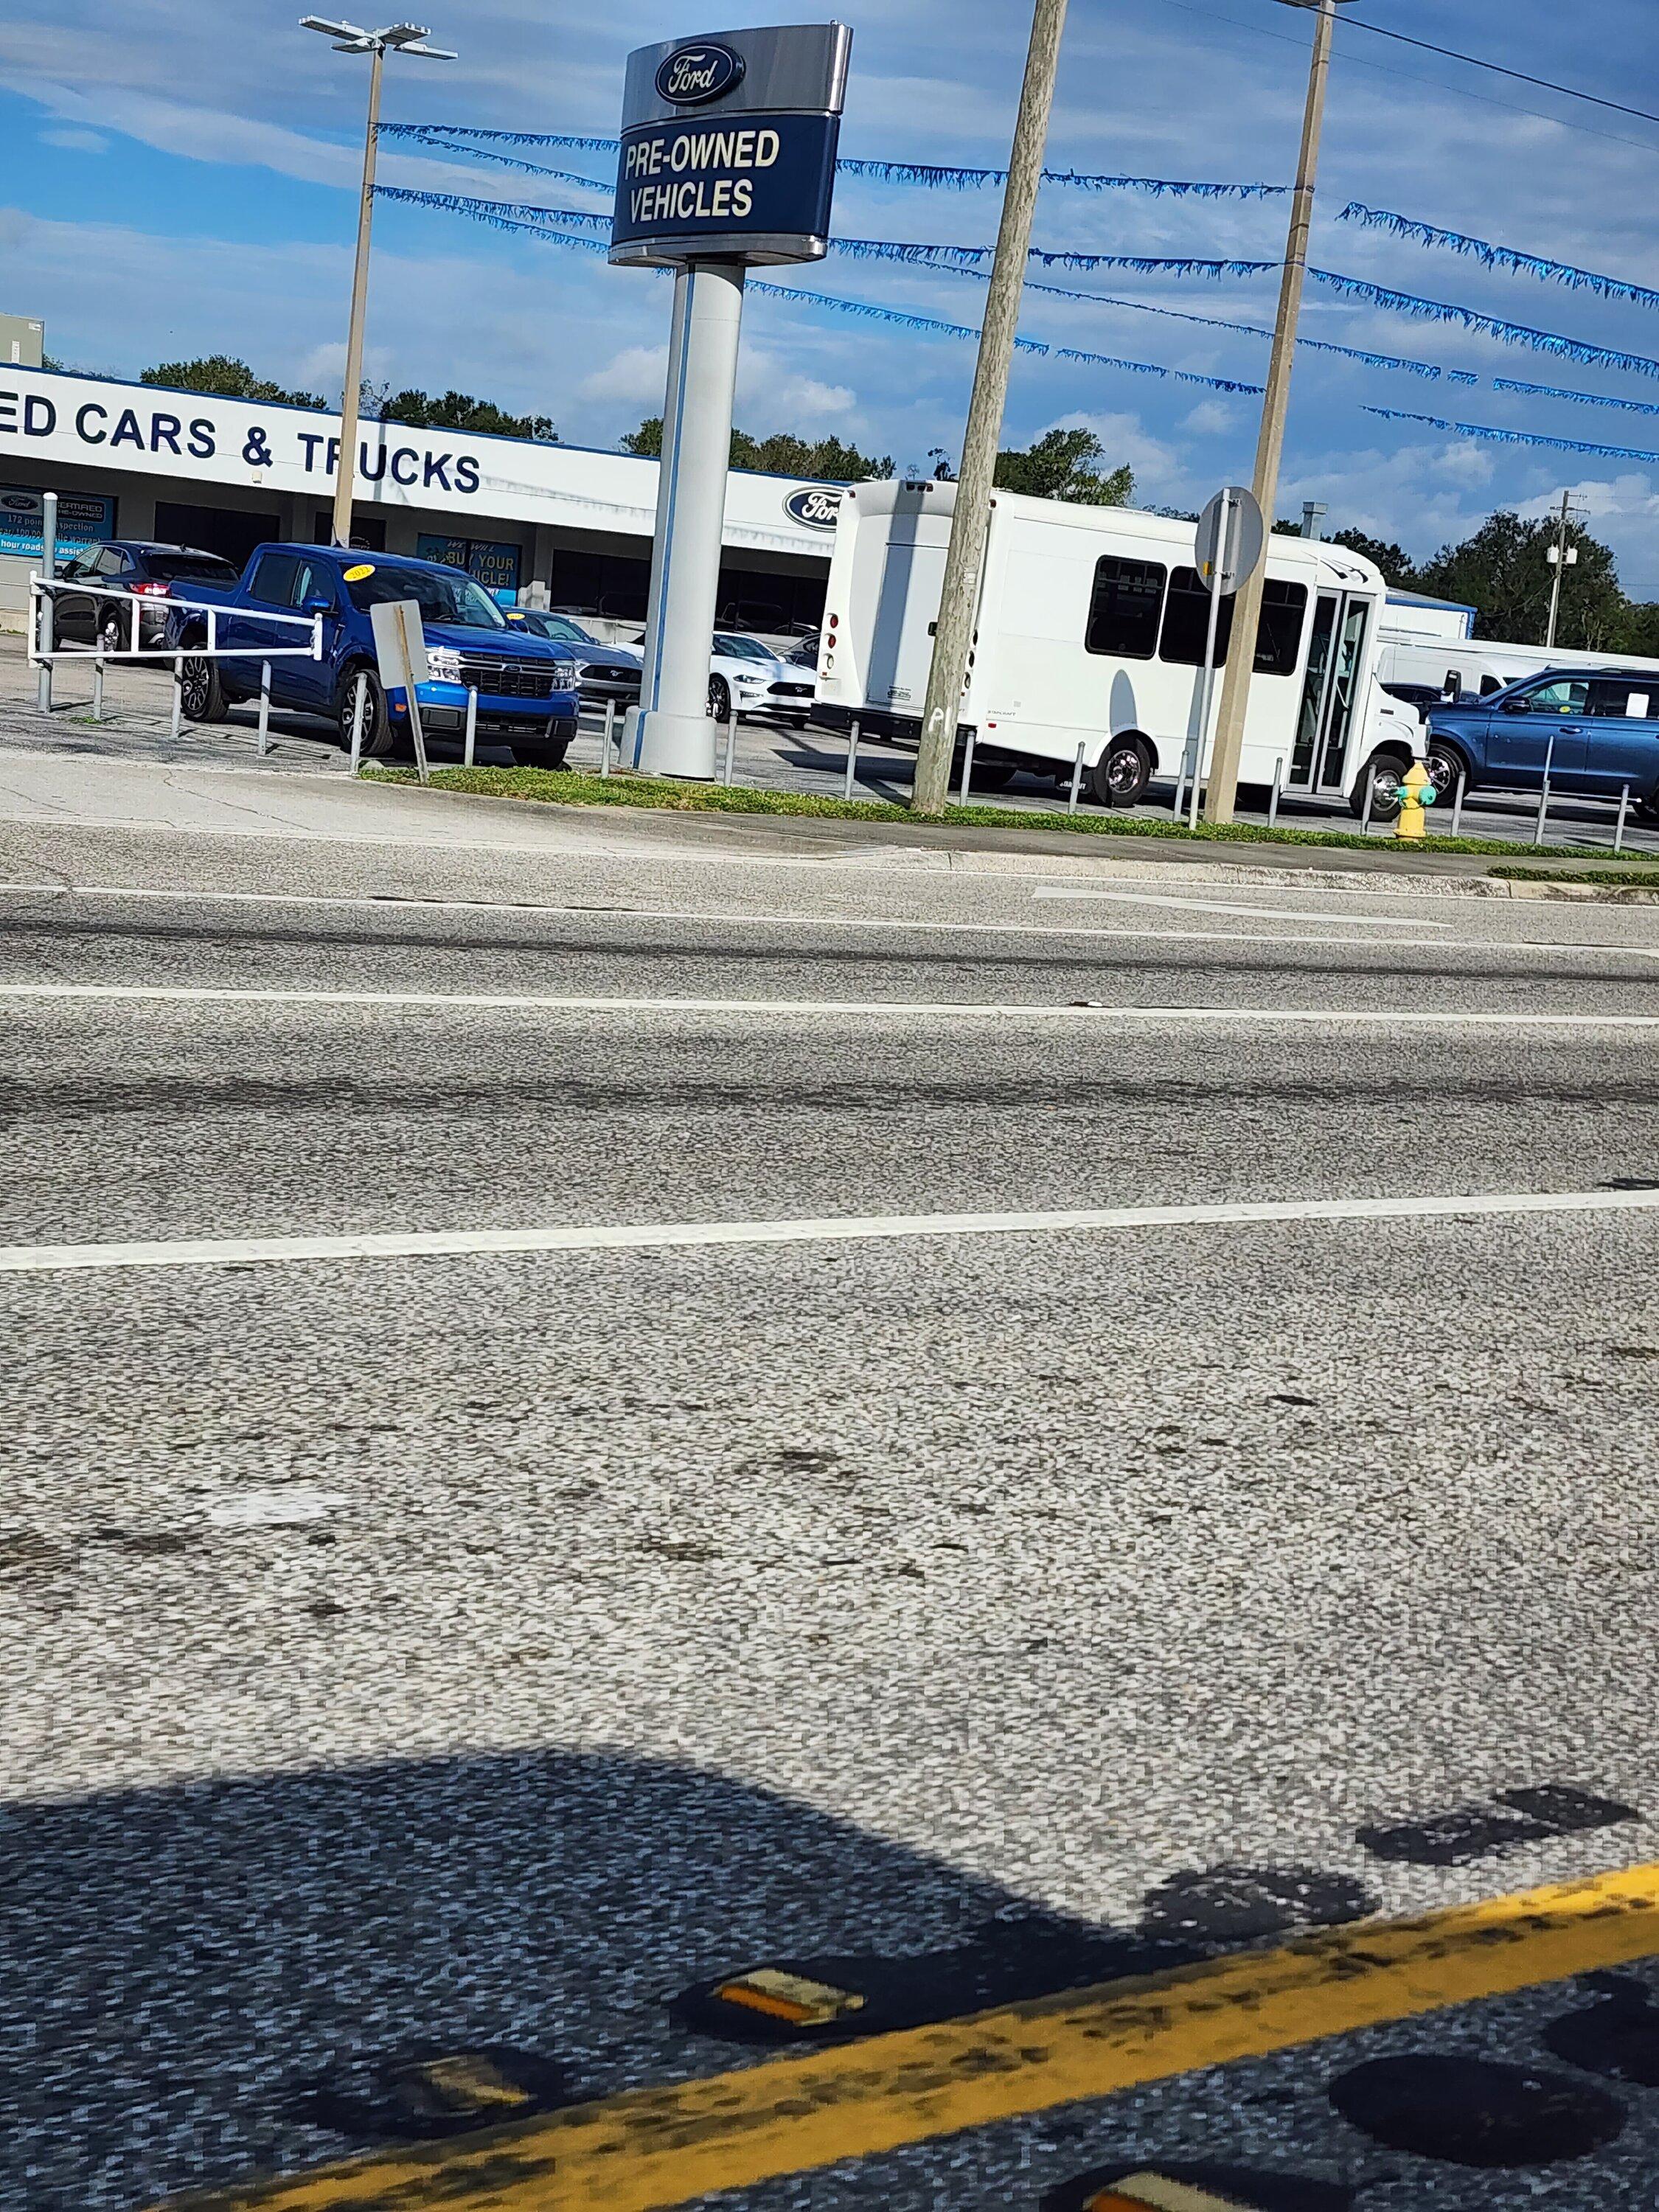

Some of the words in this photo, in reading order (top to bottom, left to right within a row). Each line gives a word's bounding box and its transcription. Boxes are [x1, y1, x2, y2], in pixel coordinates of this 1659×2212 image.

[668, 54, 718, 94] Ford
[625, 130, 779, 181] PRE-OWNED
[630, 178, 753, 223] VEHICLES
[75, 403, 216, 459] CARS
[242, 426, 274, 467] &
[57, 501, 103, 513] ERTIFIED
[58, 509, 103, 519] RE-OWNED
[801, 492, 842, 521] For
[8, 514, 22, 524] 172
[24, 518, 43, 527] poin
[1, 539, 20, 549] hour
[447, 540, 466, 549] WE
[470, 543, 495, 552] WILL
[479, 554, 514, 571] YOUR
[469, 569, 509, 586] ICLE!
